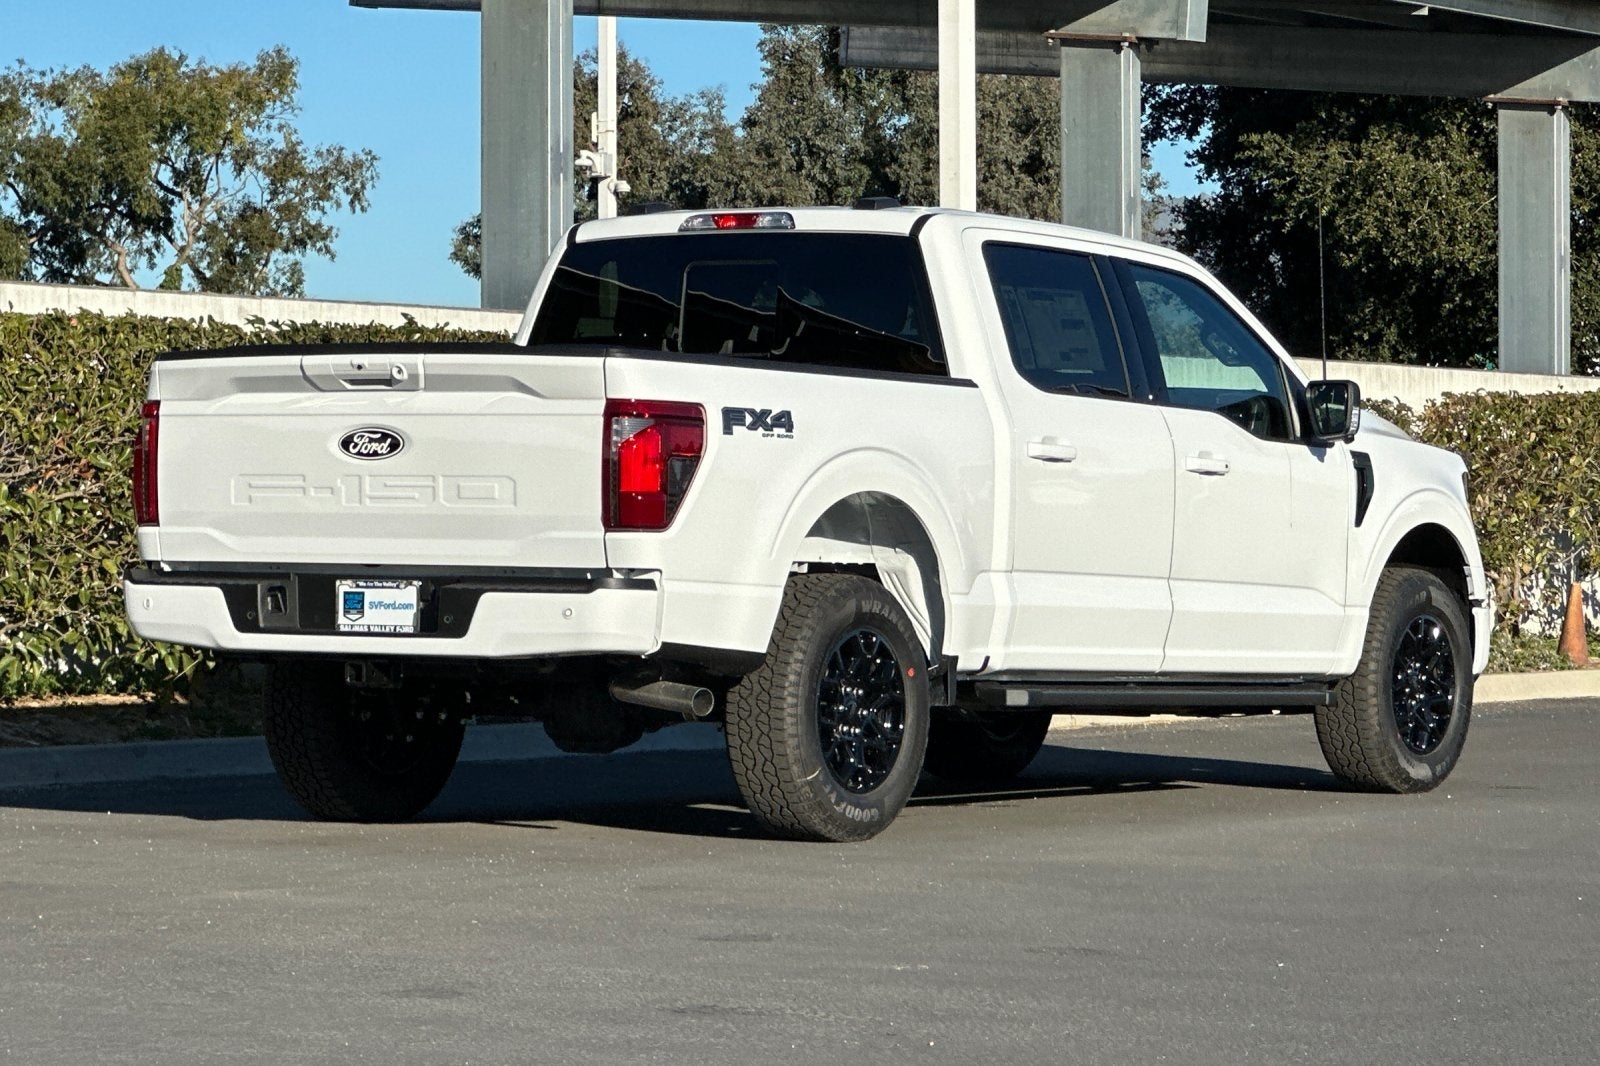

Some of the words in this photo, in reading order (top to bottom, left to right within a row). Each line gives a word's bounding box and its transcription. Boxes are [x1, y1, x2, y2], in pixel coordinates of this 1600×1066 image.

[721, 406, 794, 435] FX4
[349, 432, 391, 455] Ford
[230, 474, 518, 507] F-150
[368, 601, 414, 610] SVFord.com
[340, 624, 369, 632] SALINAS
[369, 624, 395, 633] VALLEY
